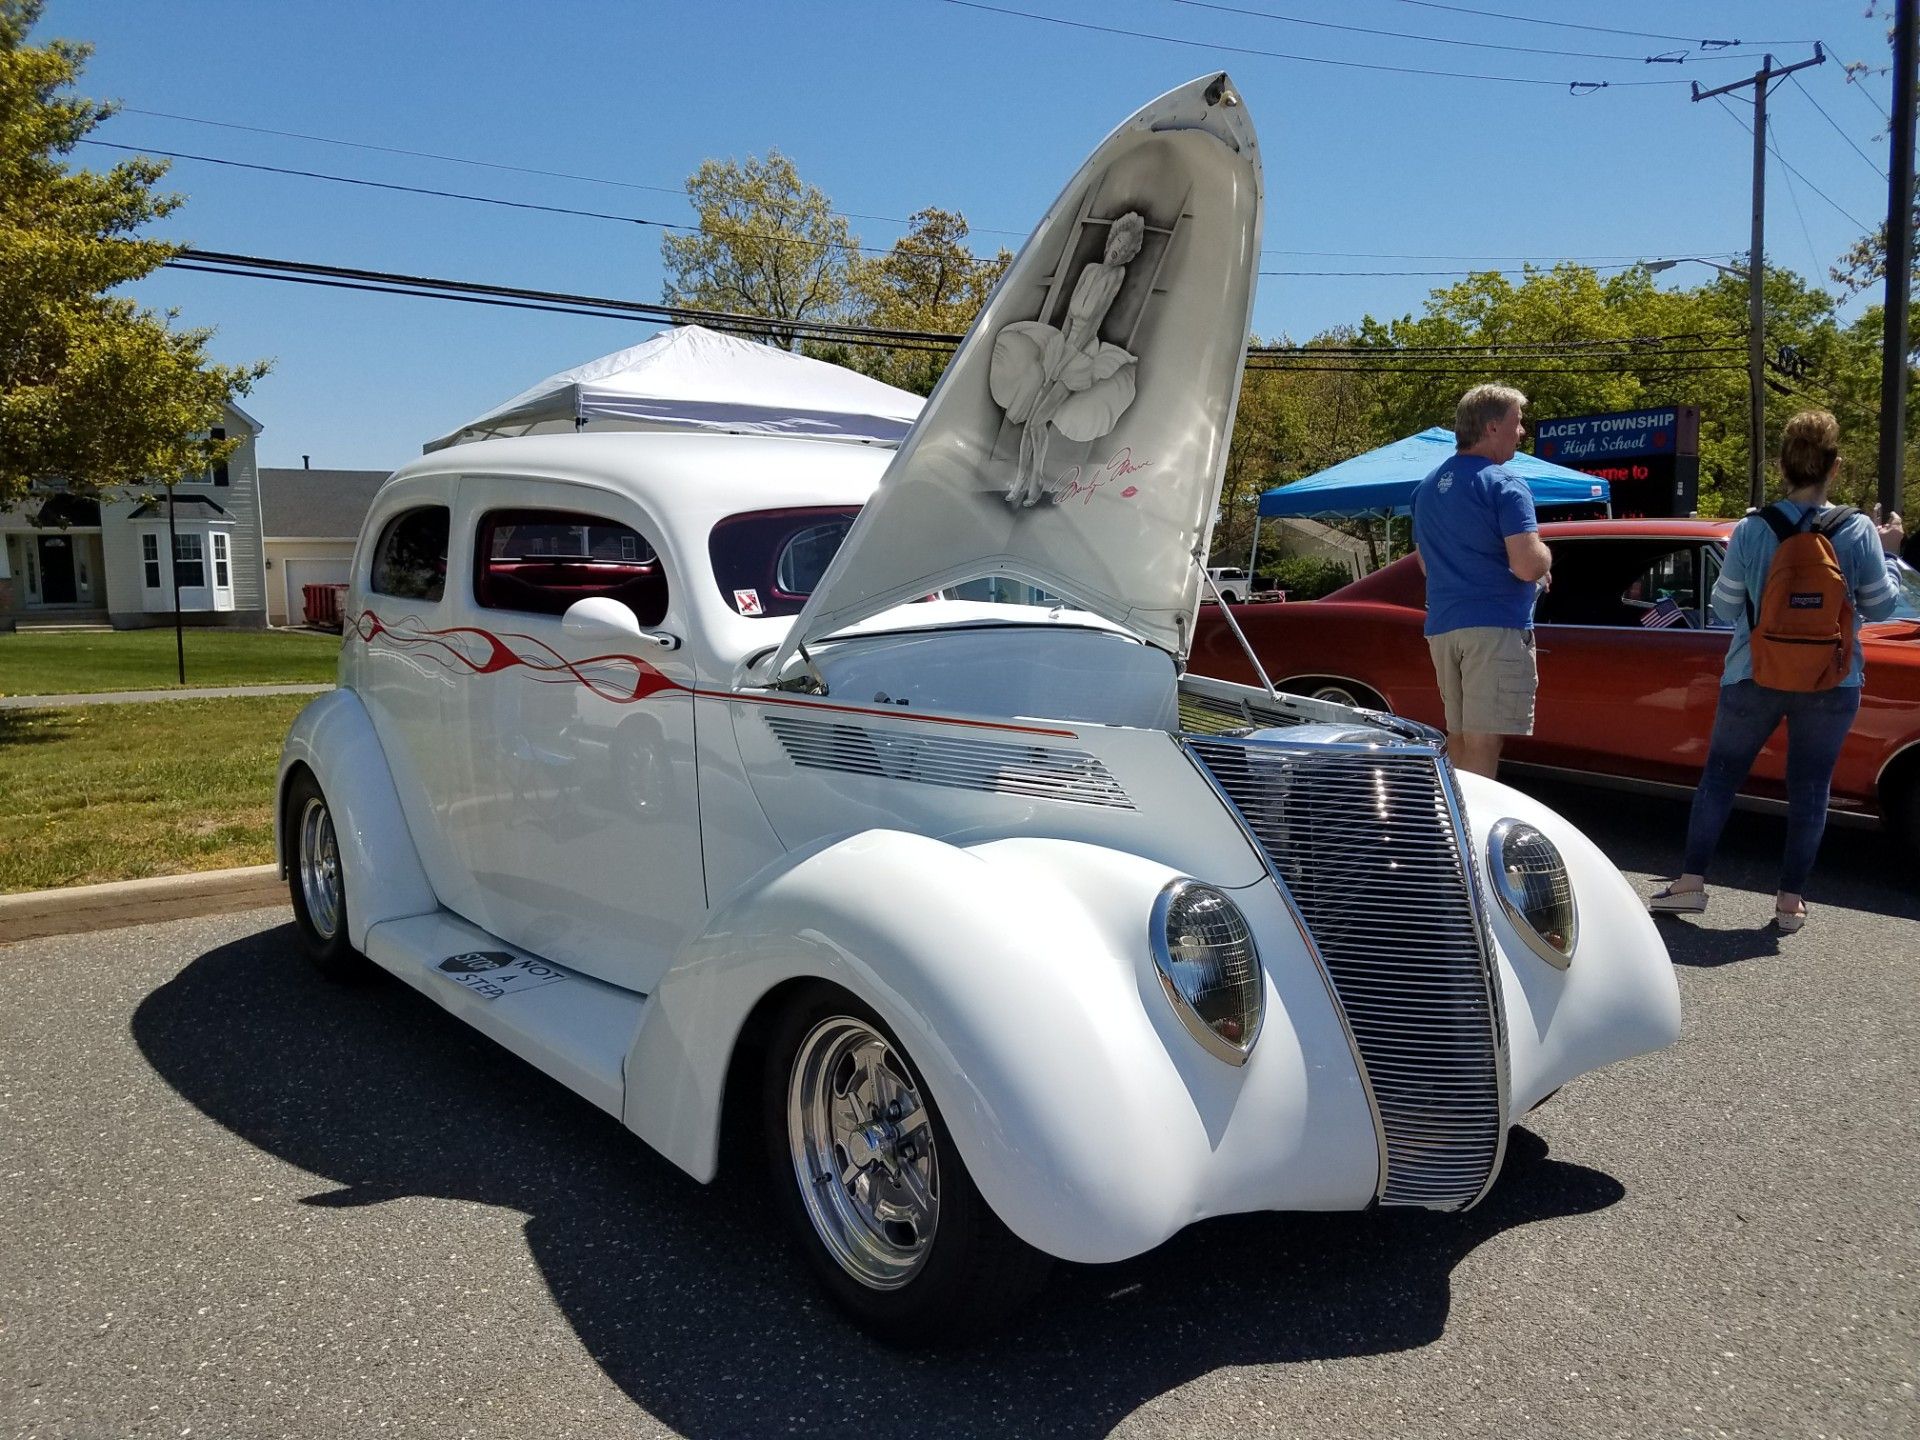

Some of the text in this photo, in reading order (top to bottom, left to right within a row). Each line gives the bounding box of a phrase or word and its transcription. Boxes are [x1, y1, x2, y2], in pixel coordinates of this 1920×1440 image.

[1539, 413, 1675, 439] LACEY TOWNSHIP
[1561, 433, 1647, 457] High School
[1633, 464, 1649, 480] to
[496, 975, 519, 983] A
[513, 960, 565, 980] NOT
[456, 974, 505, 999] STEP
